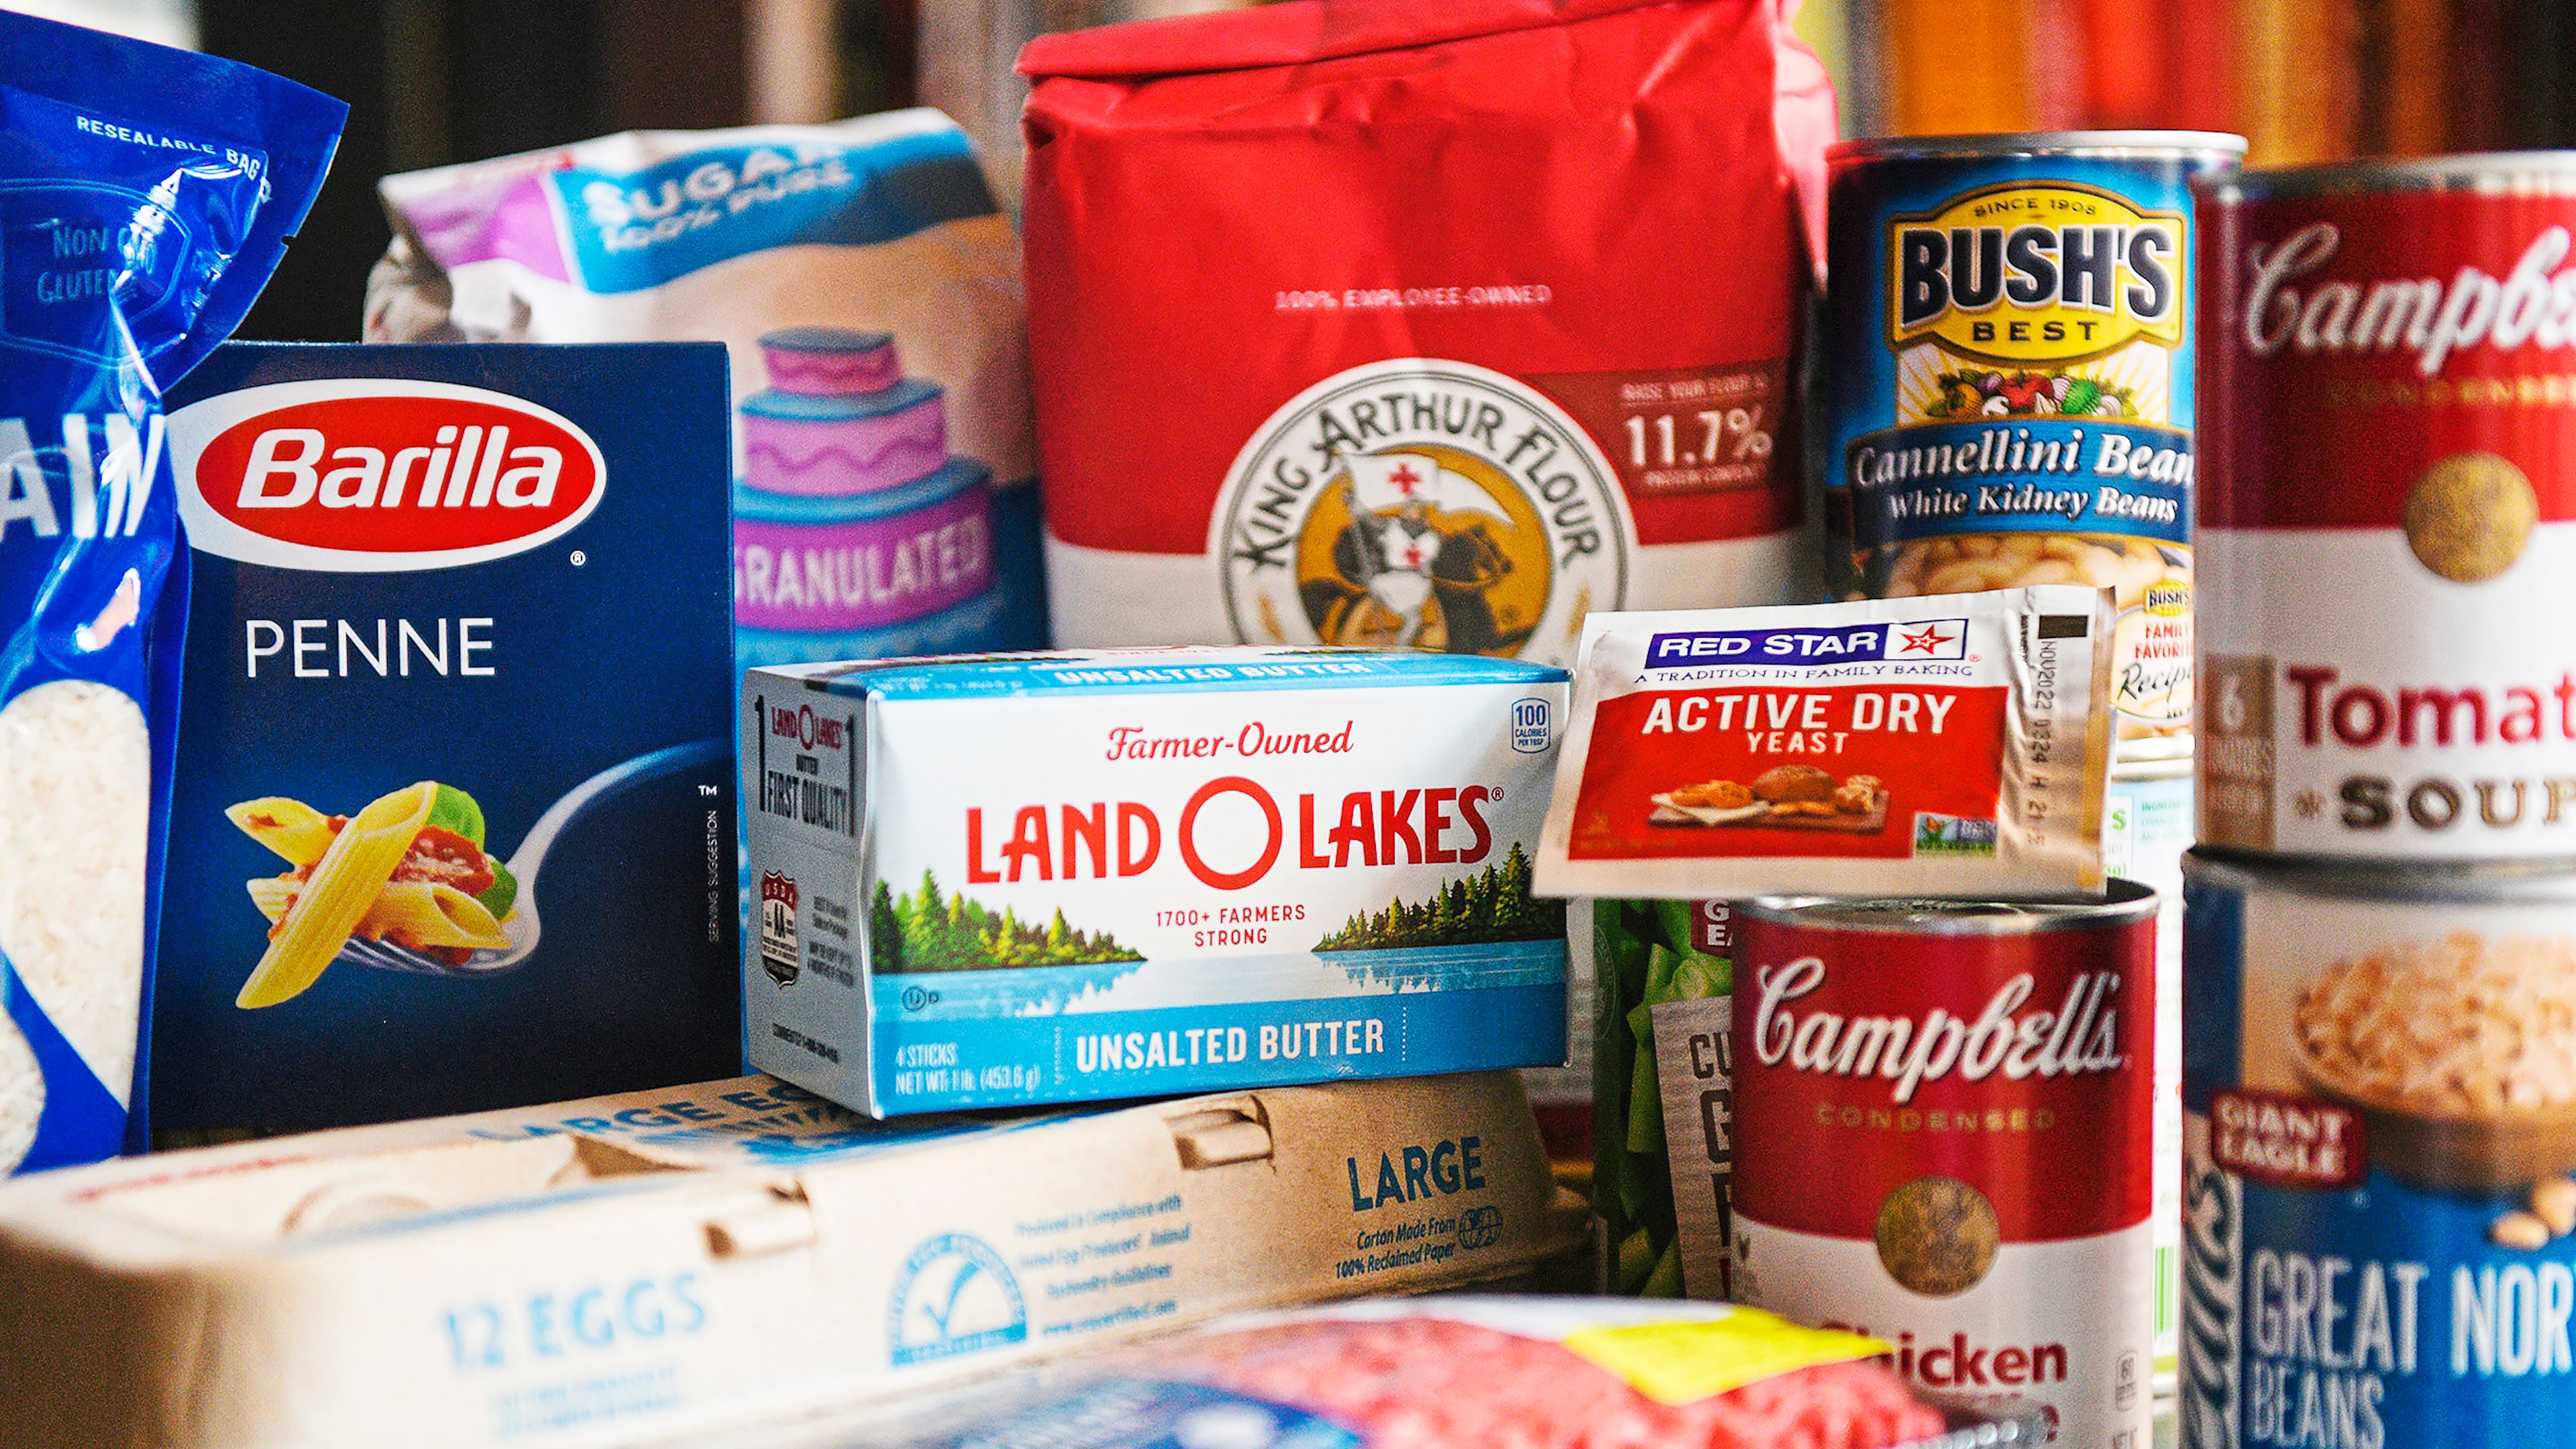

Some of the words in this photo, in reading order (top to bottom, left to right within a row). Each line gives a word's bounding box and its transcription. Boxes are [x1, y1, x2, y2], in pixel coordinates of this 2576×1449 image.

[76, 115, 216, 155] RESEALABLE
[225, 148, 261, 180] BAG
[1974, 198, 2039, 217] SINCE
[54, 227, 109, 258] NON
[1900, 223, 2176, 327] BUSH'S
[1973, 321, 2098, 343] BEST
[1626, 407, 1773, 467] 11.7%
[1856, 427, 2084, 488] Cannellini
[237, 425, 563, 508] Barilla
[1232, 455, 1311, 574] KING
[1312, 392, 1507, 475] ARTHUR
[1503, 424, 1602, 573] FLOUR
[1888, 486, 1970, 520] White
[1975, 483, 2090, 522] Kidney
[2095, 486, 2179, 523] Beans
[246, 618, 496, 678] PENNE
[1658, 637, 1752, 658] RED
[1762, 631, 1879, 657] STAR
[1055, 666, 1233, 684] UNSALTED
[1237, 663, 1373, 678] BUTTER
[1634, 675, 1647, 684] A
[1657, 668, 1766, 682] TRADITION
[1775, 669, 1799, 680] IN
[1806, 664, 1886, 678] FAMILY
[1894, 663, 1973, 677] BAKING
[772, 706, 797, 739] LAND
[1516, 705, 1546, 726] 100
[1642, 694, 1831, 735] ACTIVE
[1851, 692, 1957, 734] DRY
[1106, 720, 1354, 761] Farmer-Owned
[1748, 731, 1849, 754] YEAST
[698, 785, 718, 796] TM
[768, 770, 799, 820] FIRST
[802, 779, 849, 837] QUALITY
[706, 810, 718, 886] SUGGESTION
[966, 801, 1161, 884] LAND
[1179, 775, 1283, 890] O
[1157, 909, 1210, 928] 1700+
[1220, 905, 1305, 924] FARMERS
[1195, 928, 1267, 947] STRONG
[1077, 1028, 1246, 1073] UNSALTED
[1260, 1018, 1383, 1061] BUTTER
[1755, 956, 2123, 1104] Campbell's
[895, 1046, 906, 1067] 4
[907, 1042, 959, 1068] STICKS
[896, 1071, 924, 1095] NET
[1815, 1104, 2056, 1134] CONDENSED
[1347, 1136, 1486, 1212] LARGE
[1356, 1230, 1394, 1250] Carton
[1395, 1221, 1426, 1242] Made
[1428, 1216, 1457, 1236] From
[1336, 1257, 1365, 1279] 100%
[1367, 1243, 1422, 1274] Reclaimed
[1424, 1241, 1456, 1265] Paper
[529, 1271, 706, 1356] EGGS
[2246, 1248, 2430, 1374] GREAT
[1820, 1320, 2069, 1386] icken
[2248, 1359, 2386, 1449] BEANS
